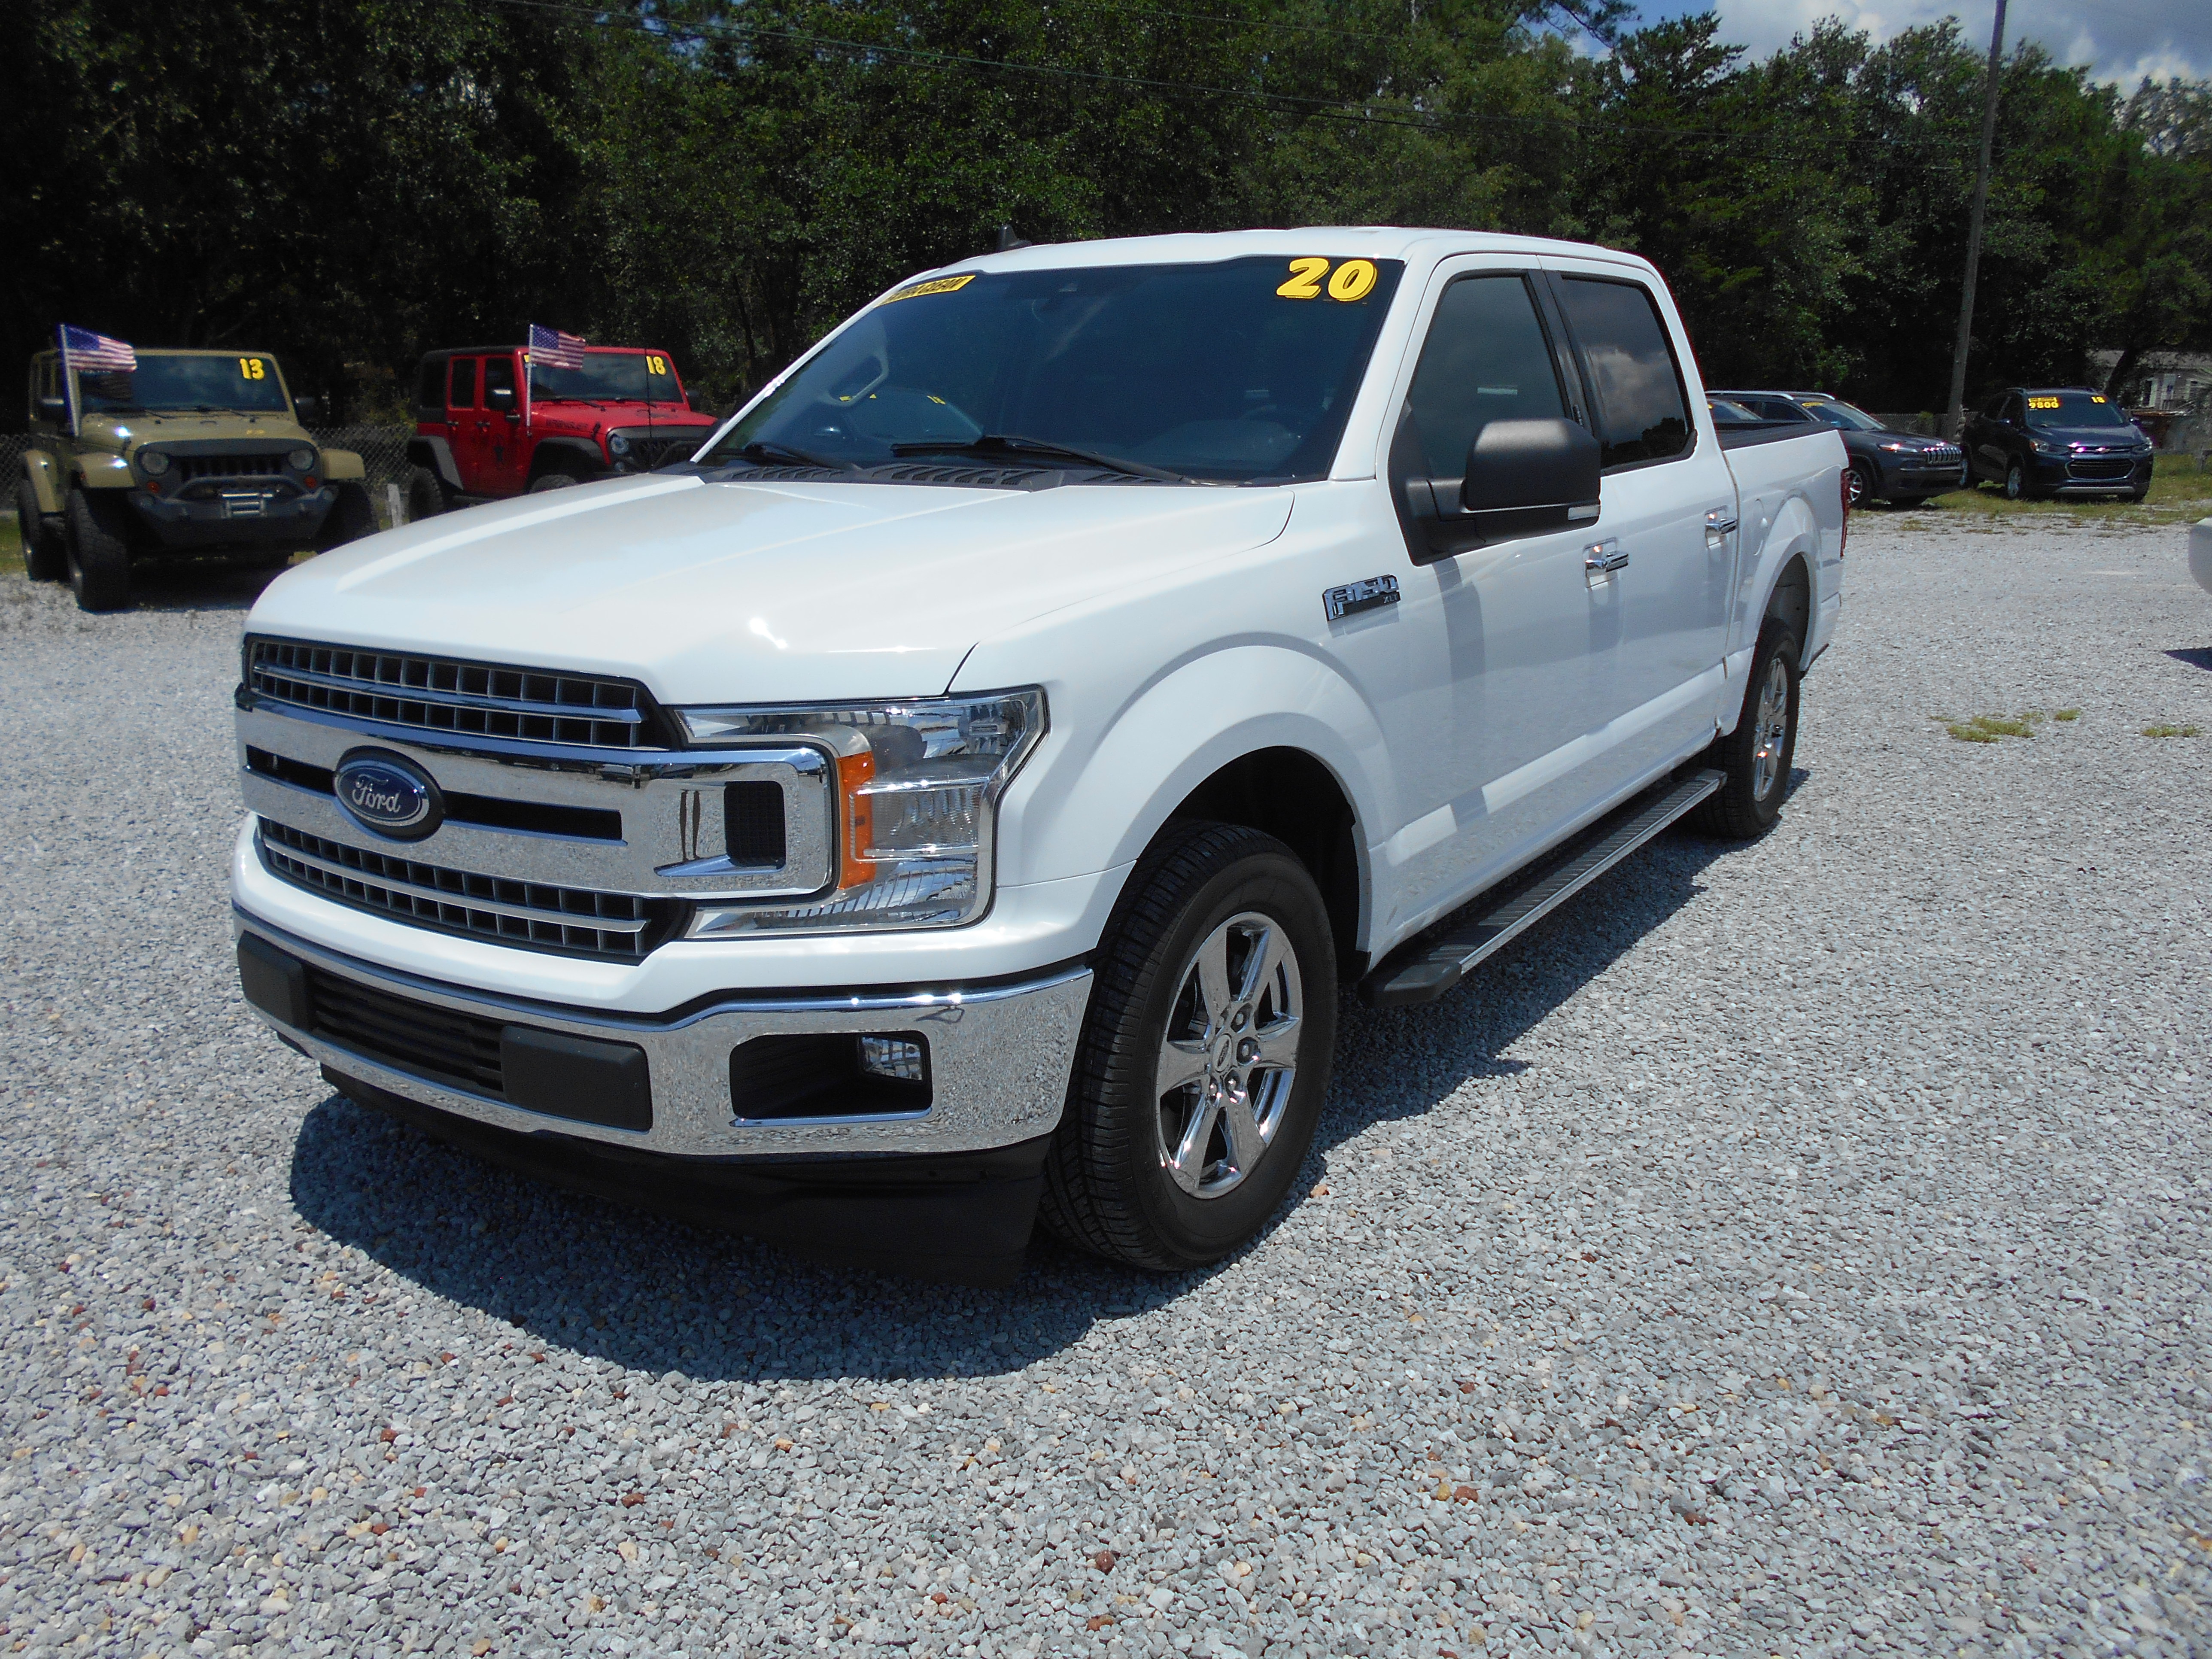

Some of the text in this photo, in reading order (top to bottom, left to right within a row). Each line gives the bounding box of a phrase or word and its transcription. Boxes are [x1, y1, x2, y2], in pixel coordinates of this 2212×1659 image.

[1276, 257, 1377, 302] 20
[240, 358, 264, 380] 13
[646, 356, 667, 375] 18
[1383, 594, 1398, 603] XLT
[352, 774, 401, 813] Ford
